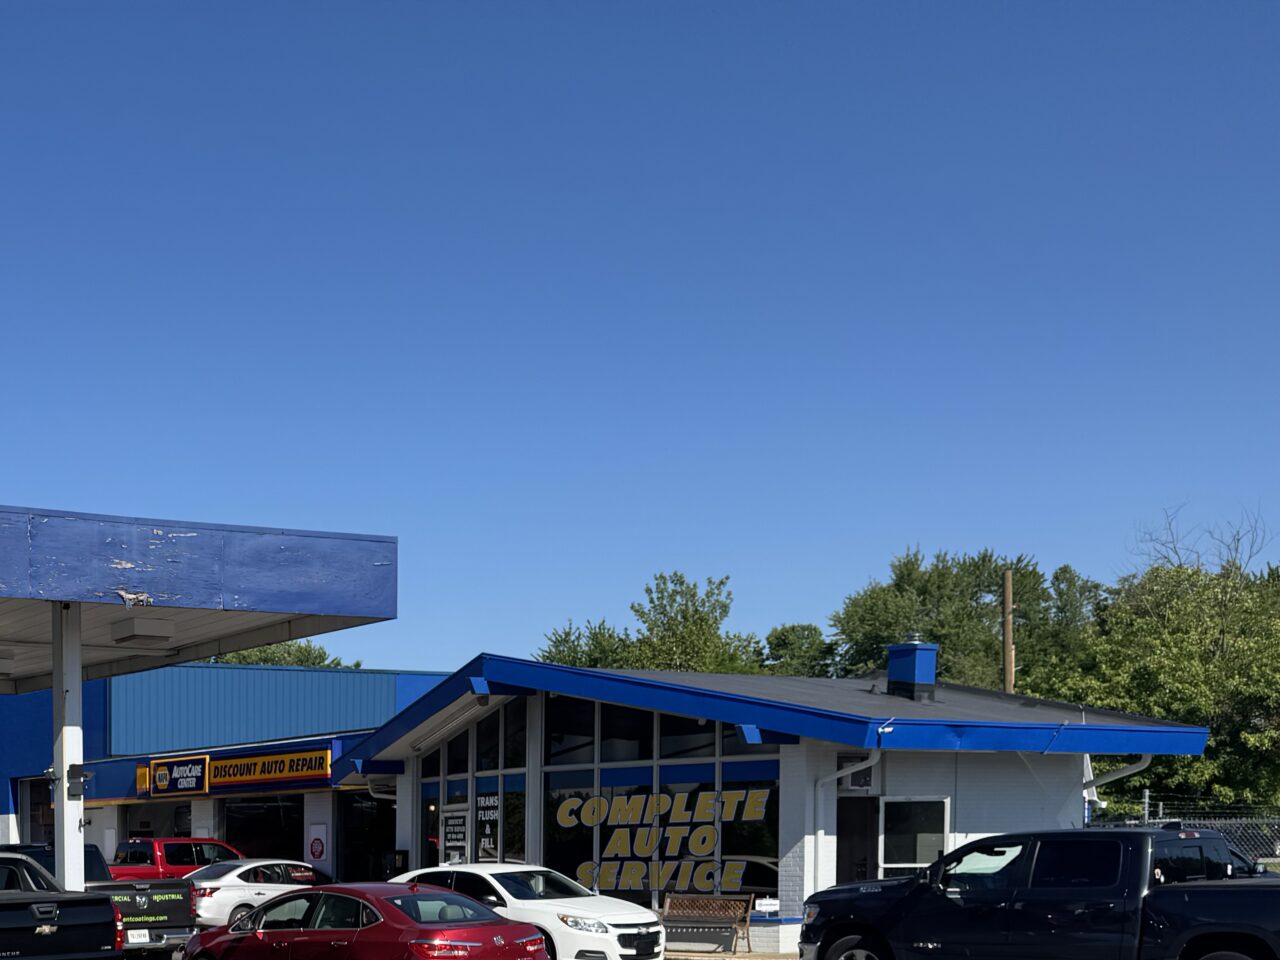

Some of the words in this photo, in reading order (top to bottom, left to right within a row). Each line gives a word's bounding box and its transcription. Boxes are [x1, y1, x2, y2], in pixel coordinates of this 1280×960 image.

[213, 762, 257, 779] DISCOUNT
[260, 759, 285, 775] AUTO
[288, 756, 325, 773] REPAIR
[157, 771, 168, 784] NAPA
[177, 777, 196, 789] CENTER
[477, 796, 499, 808] TRANS
[556, 788, 770, 828] COMPLETE
[478, 809, 499, 821] FLUSH
[485, 823, 491, 834] &
[481, 837, 495, 849] FILL
[601, 825, 718, 858] AUTO
[575, 860, 749, 892] SERVICE
[152, 893, 183, 902] INDUSTRIAL
